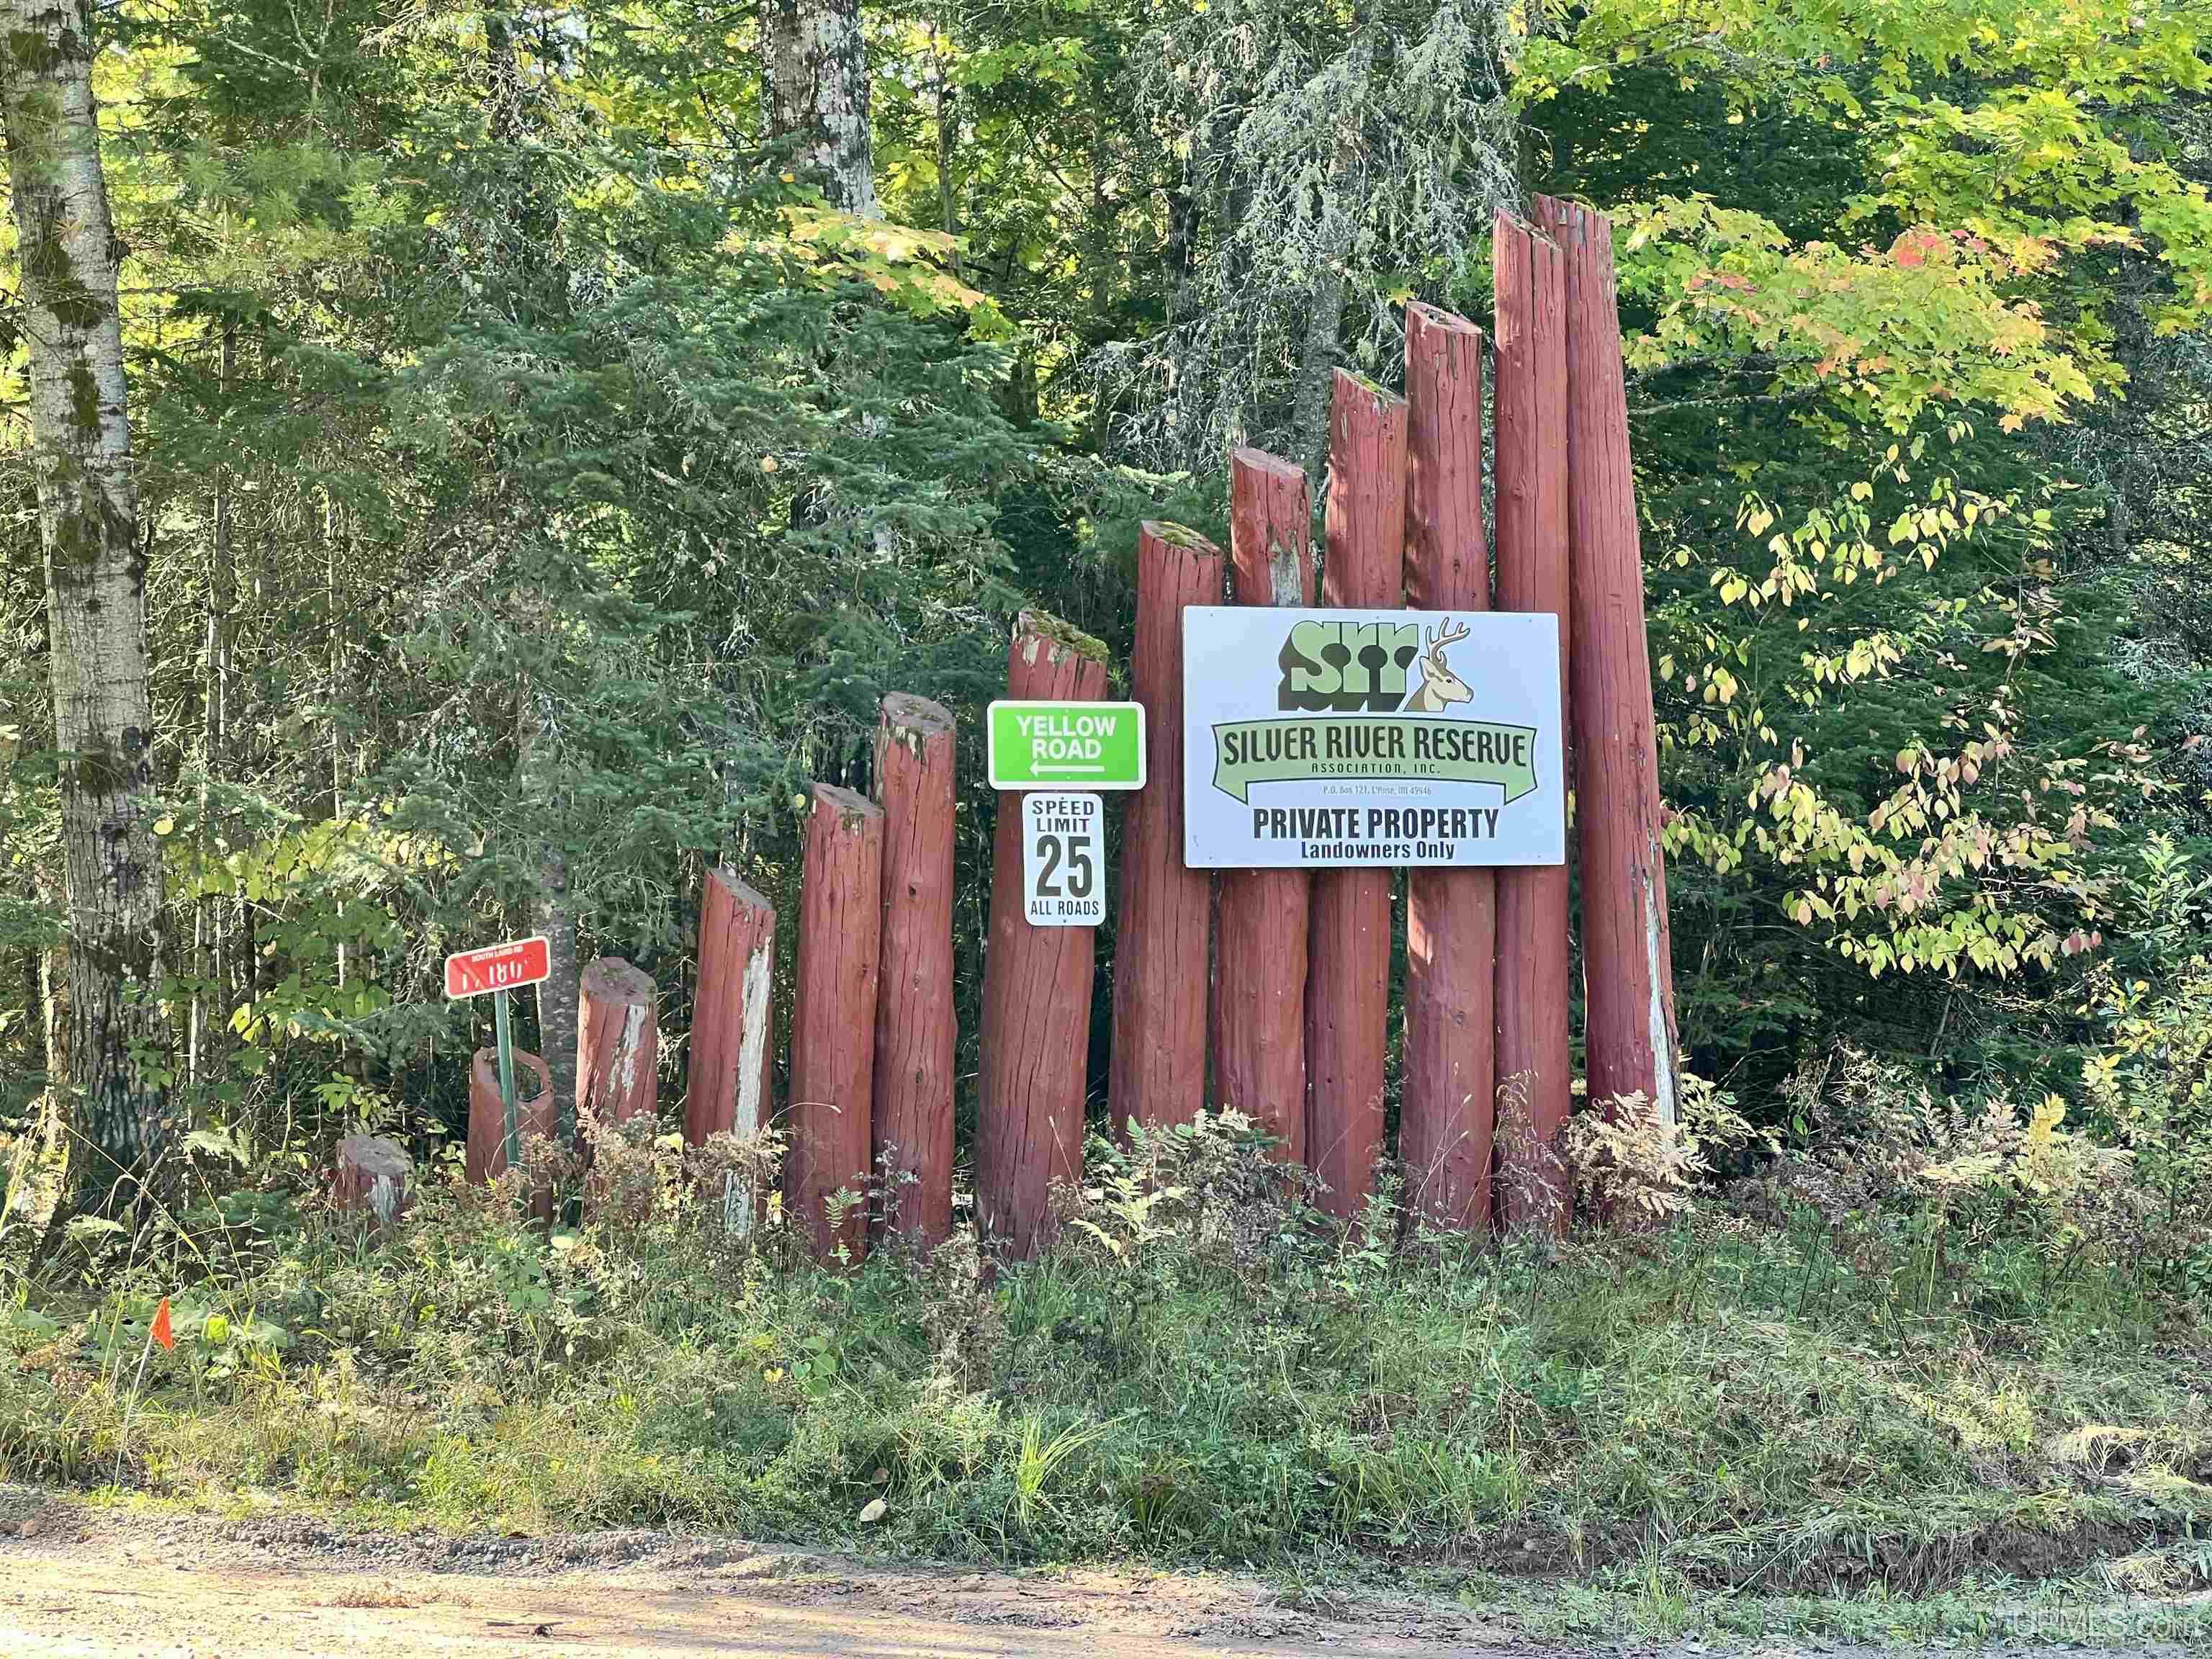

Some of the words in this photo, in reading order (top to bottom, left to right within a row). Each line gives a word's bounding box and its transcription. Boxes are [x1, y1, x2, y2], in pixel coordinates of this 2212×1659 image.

[1015, 715, 1117, 737] YELLOW
[1032, 739, 1102, 760] ROAD
[1223, 726, 1318, 765] SILVER
[1326, 725, 1406, 759] RIVER
[1413, 726, 1527, 767] RESERVE
[1032, 800, 1094, 815] SPEED
[1036, 818, 1091, 832] LIMIT
[1253, 808, 1360, 839] PRIVATE
[1367, 808, 1499, 839] PROPERTY
[1301, 841, 1411, 859] Landowners
[1416, 841, 1455, 860] Only
[1035, 835, 1093, 898] 25
[1030, 901, 1052, 916] ALL
[1058, 901, 1100, 916] ROADS
